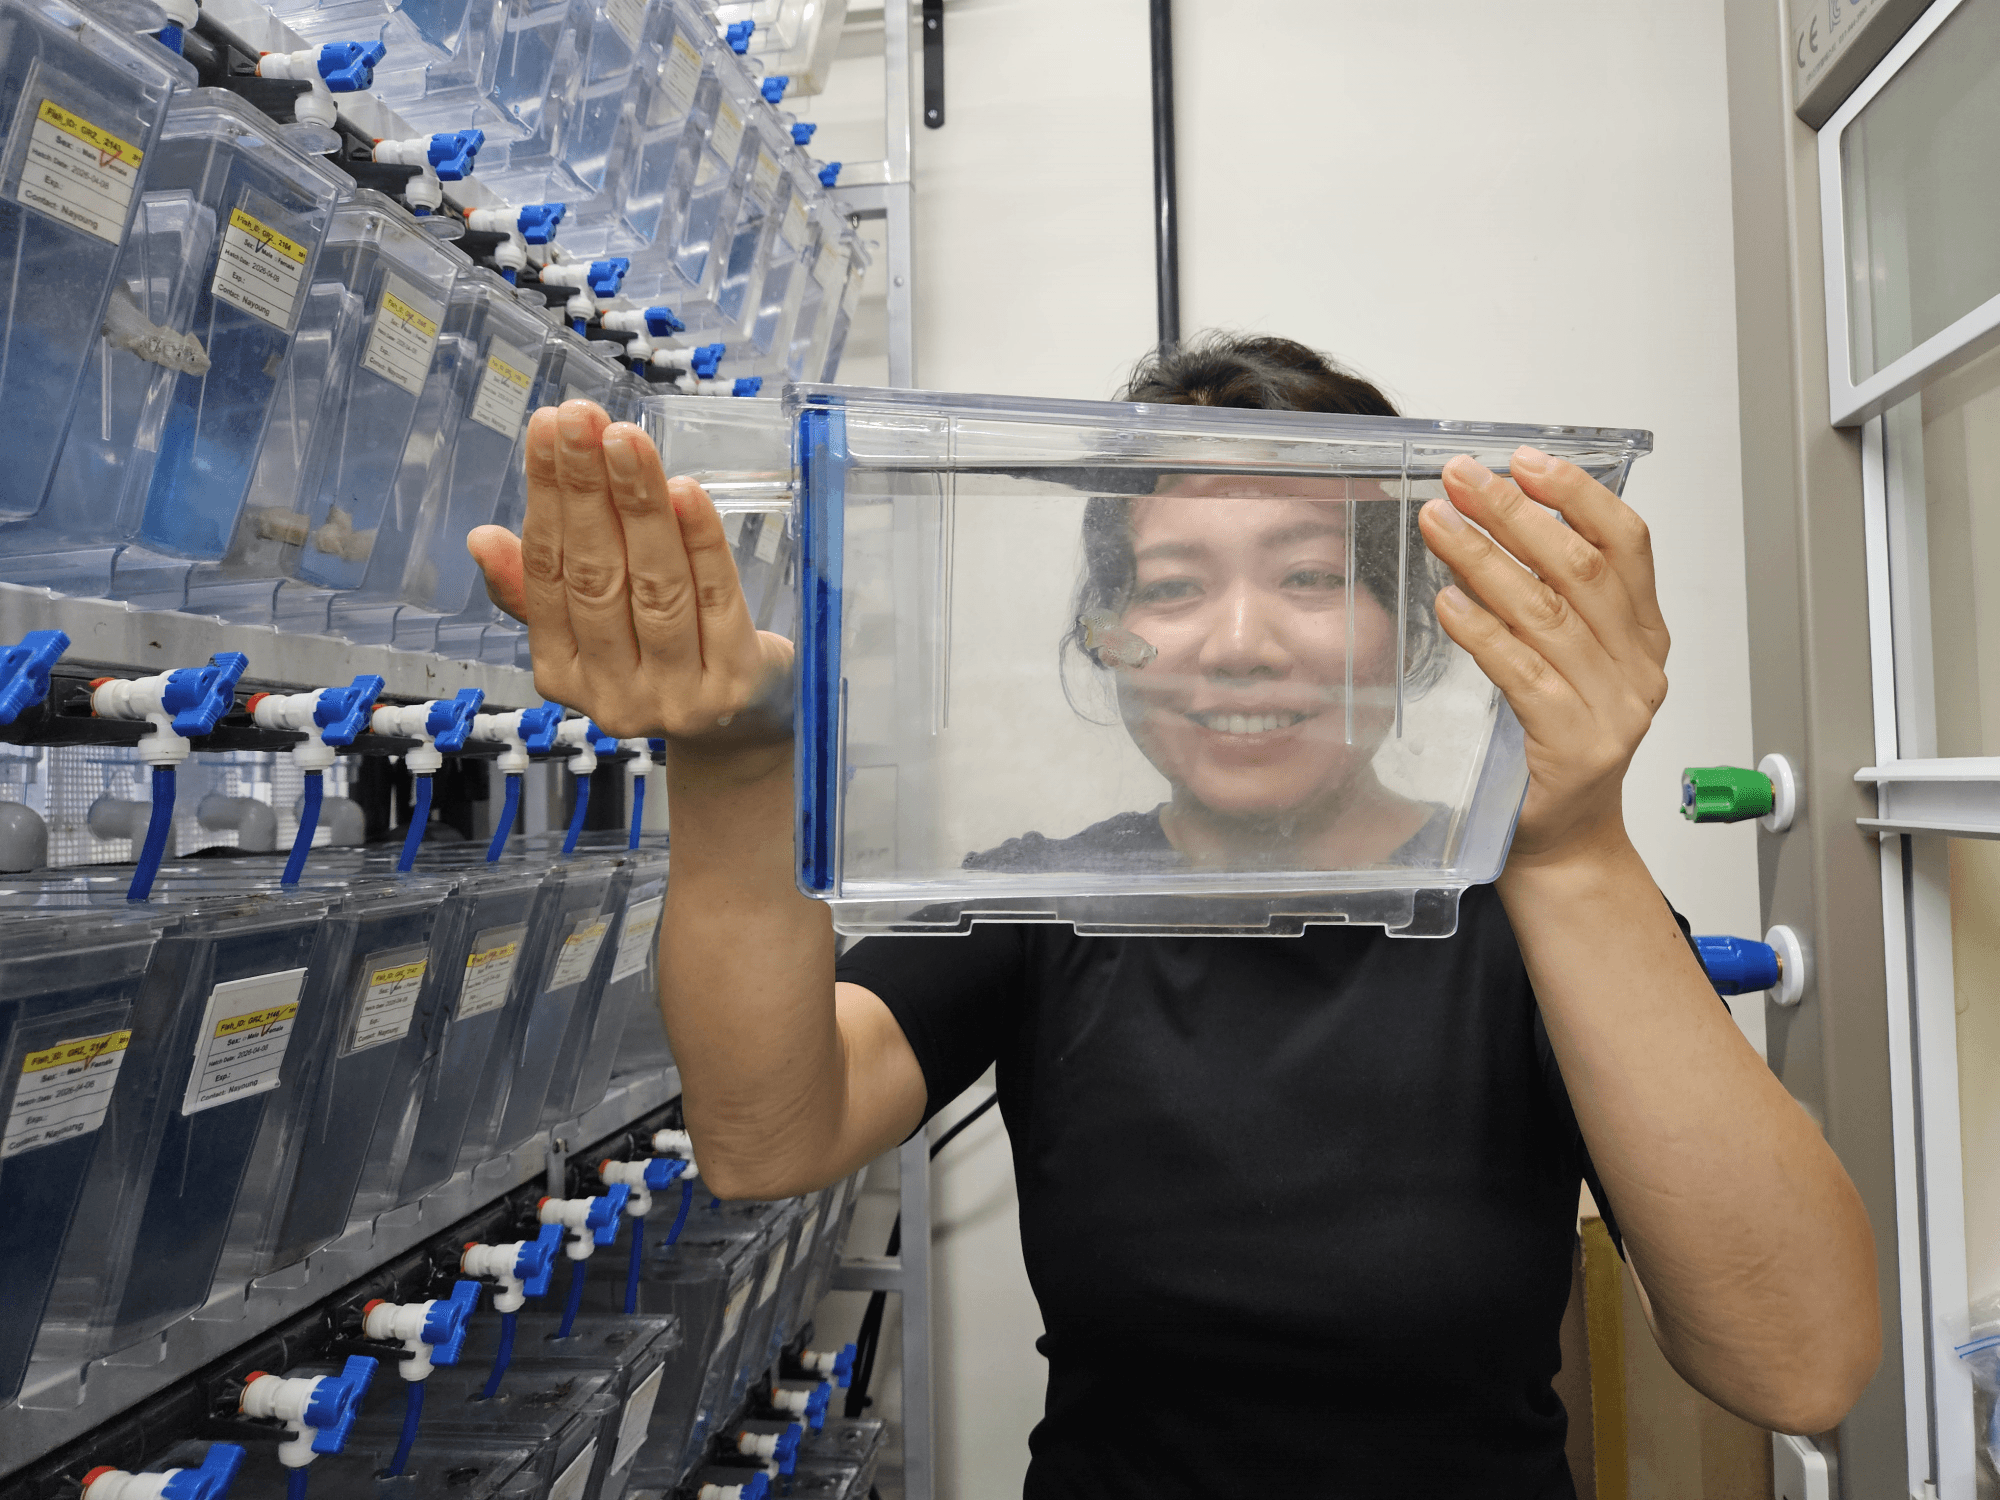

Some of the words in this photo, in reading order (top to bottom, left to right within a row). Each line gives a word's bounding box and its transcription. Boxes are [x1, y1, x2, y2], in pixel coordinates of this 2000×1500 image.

[60, 205, 98, 230] Nayoung
[261, 248, 272, 258] Male
[278, 257, 294, 270] Female
[218, 283, 239, 299] Contact:
[242, 296, 269, 316] Nayoung
[227, 1036, 240, 1045] Sex:
[201, 1090, 225, 1100] Contact:
[228, 1080, 257, 1092] Nayoung
